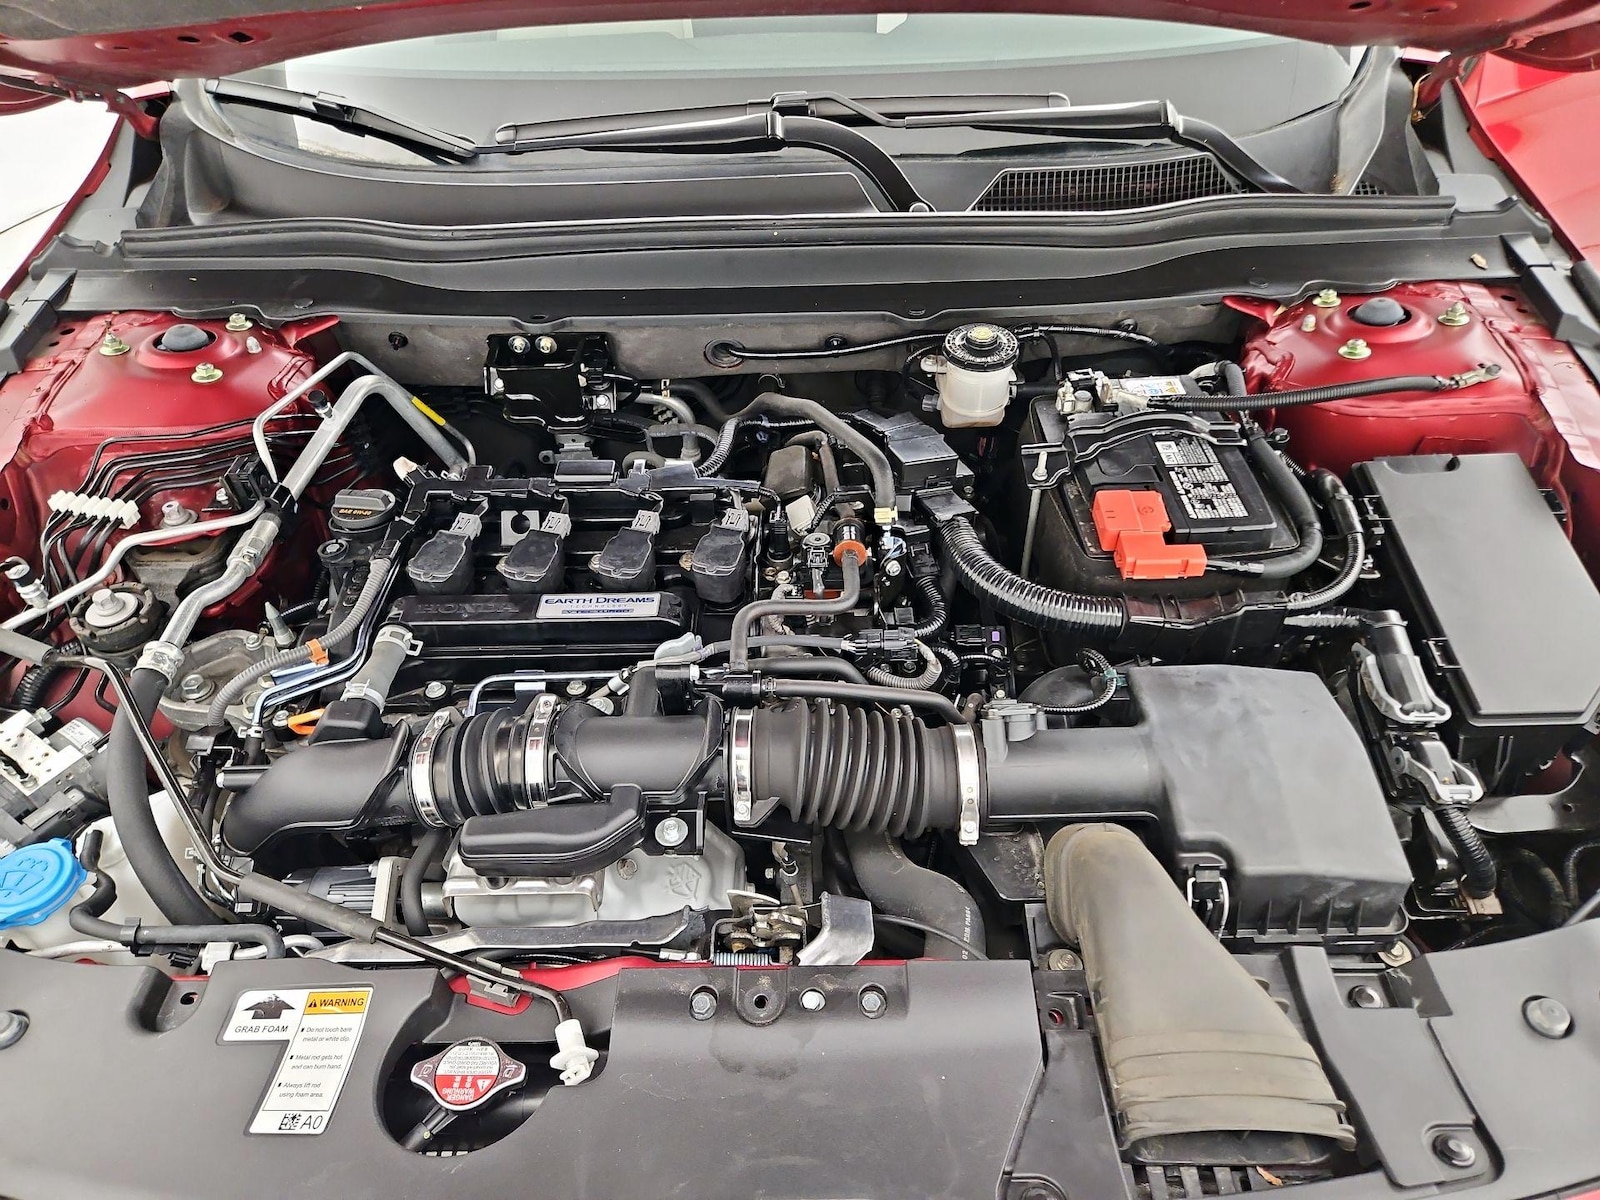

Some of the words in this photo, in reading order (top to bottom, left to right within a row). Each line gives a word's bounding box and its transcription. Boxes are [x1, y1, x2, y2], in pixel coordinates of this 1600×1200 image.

[416, 602, 519, 614] HONDA
[319, 998, 364, 1007] WARNING
[262, 1025, 289, 1033] FOAM
[442, 1088, 475, 1096] WARNING
